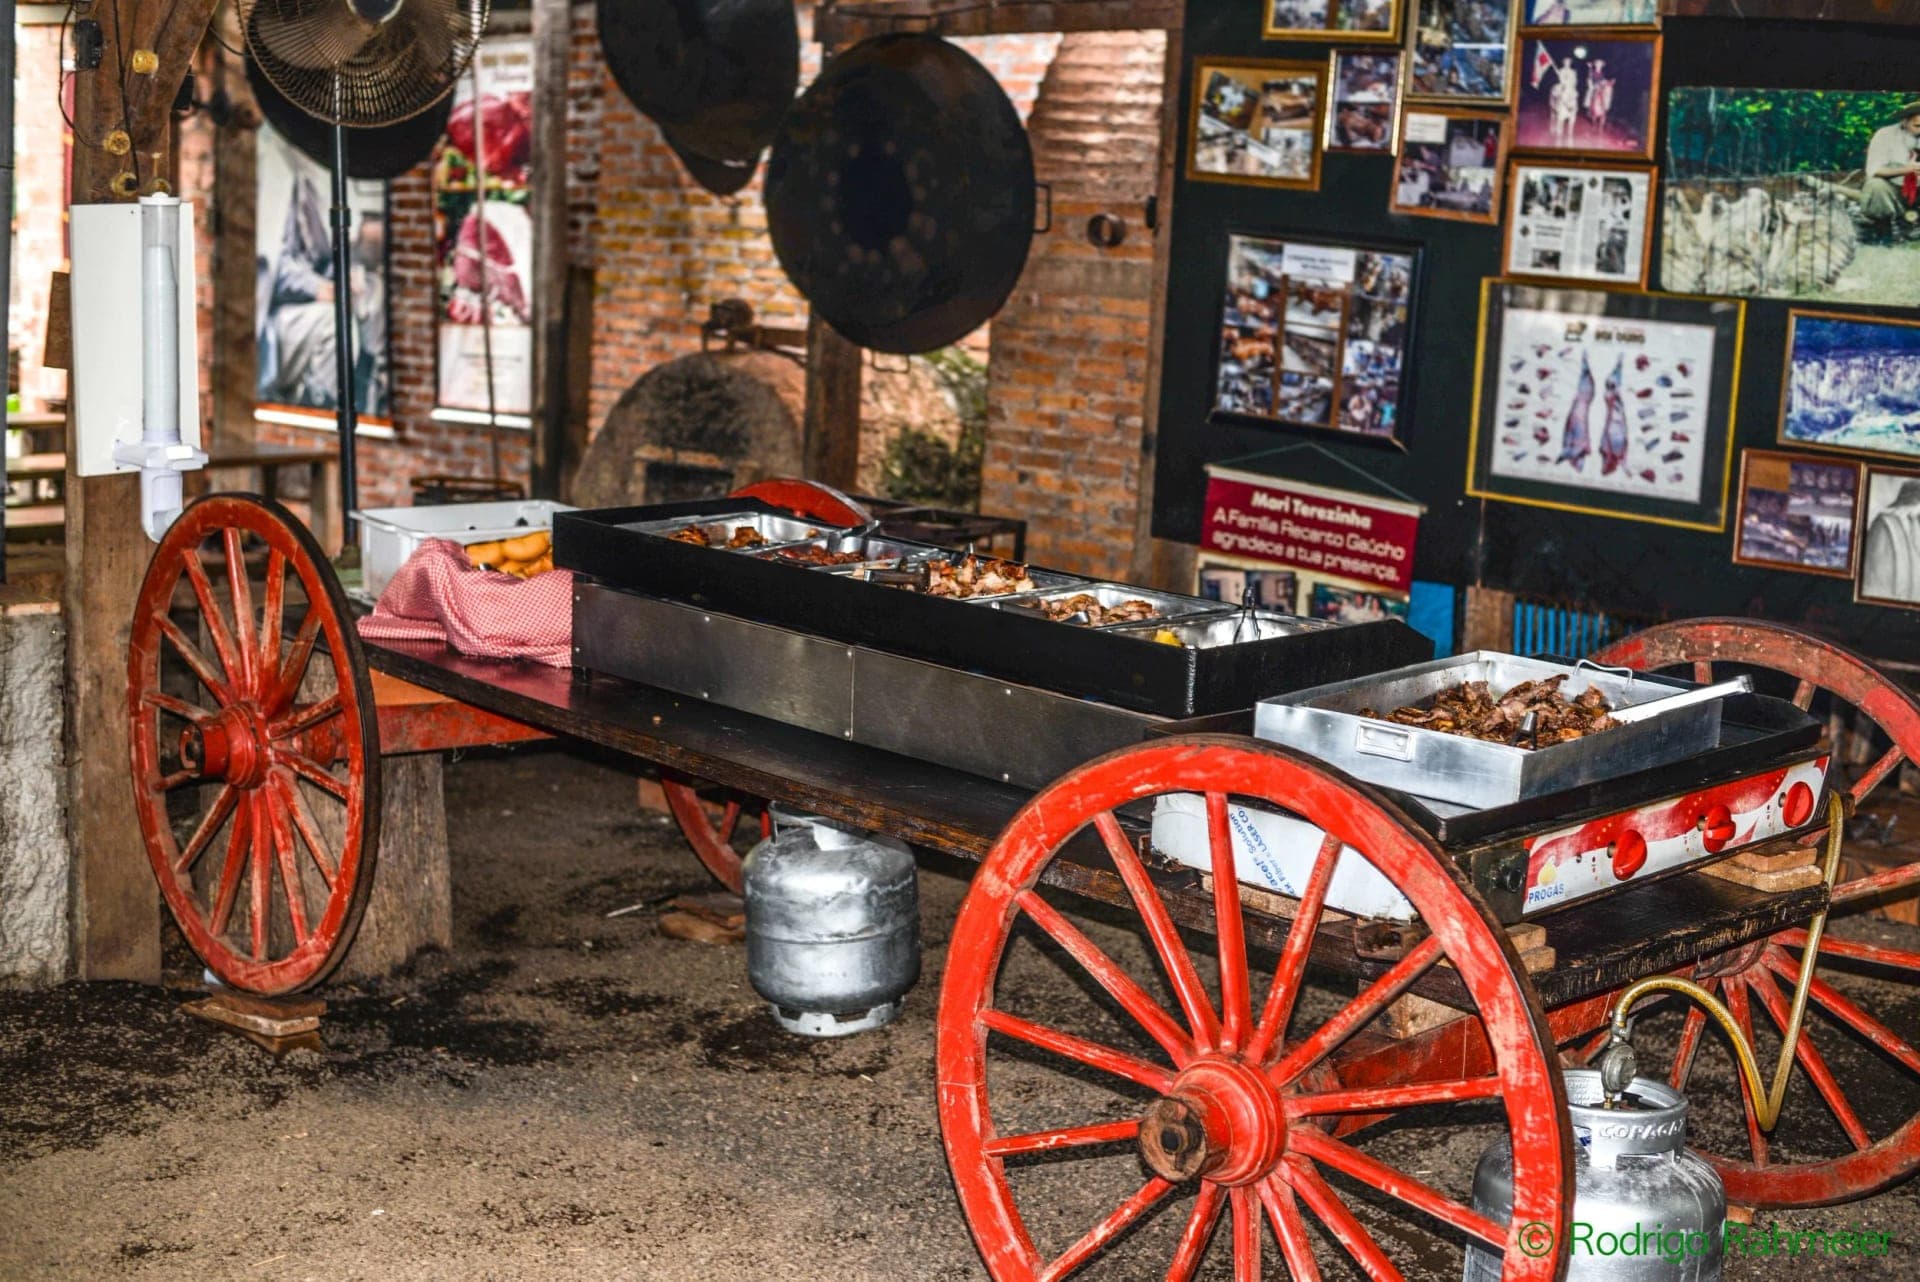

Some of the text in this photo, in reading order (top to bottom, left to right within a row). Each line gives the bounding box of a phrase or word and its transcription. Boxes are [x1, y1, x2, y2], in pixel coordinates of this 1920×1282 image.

[1212, 506, 1228, 525] A
[1280, 519, 1344, 548] Recanto
[1346, 532, 1406, 561] Gaúcho
[1251, 490, 1372, 531] Mari Terezinha
[1212, 530, 1401, 583] agradece a tua presença.
[1247, 823, 1267, 853] LASER
